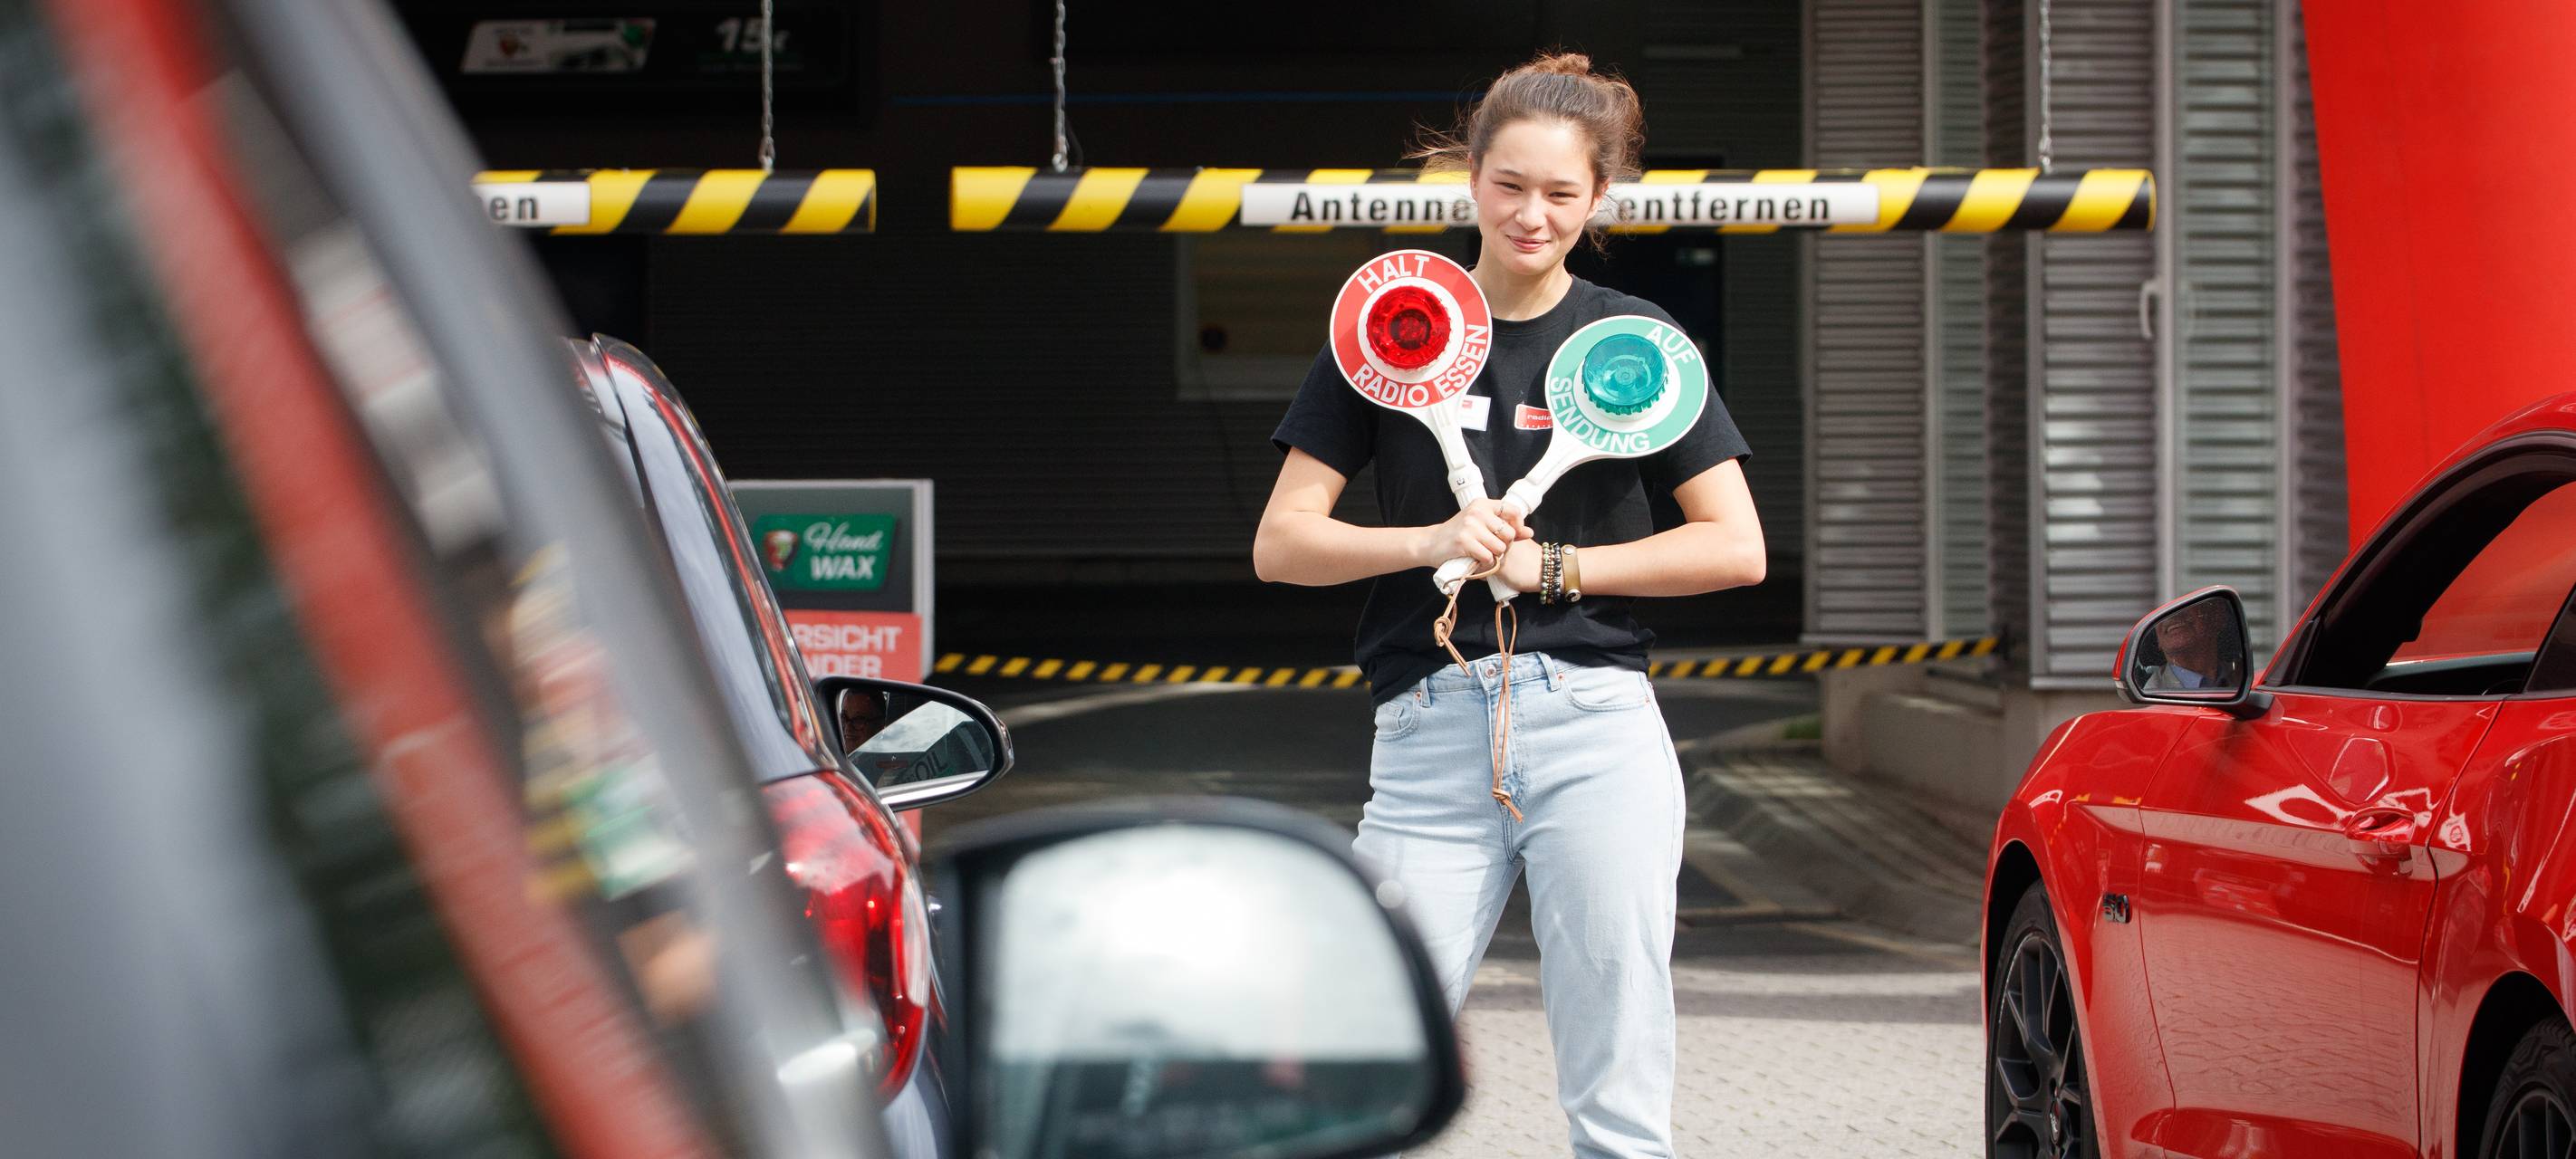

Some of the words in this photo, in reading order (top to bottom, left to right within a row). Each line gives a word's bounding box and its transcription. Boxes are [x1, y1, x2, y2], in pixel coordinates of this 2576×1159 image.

[1291, 191, 1471, 221] Antenne
[1618, 191, 1830, 221] entfernen
[1357, 254, 1430, 294] HALT
[1646, 325, 1697, 365] AUF
[1352, 363, 1429, 407] RADIO
[1433, 323, 1488, 399] ESSEN
[1550, 376, 1651, 453] SENDUNG
[803, 522, 884, 553] Hand
[811, 555, 876, 580] WAX
[792, 623, 902, 652] RSICHT
[803, 653, 882, 679] NDER
